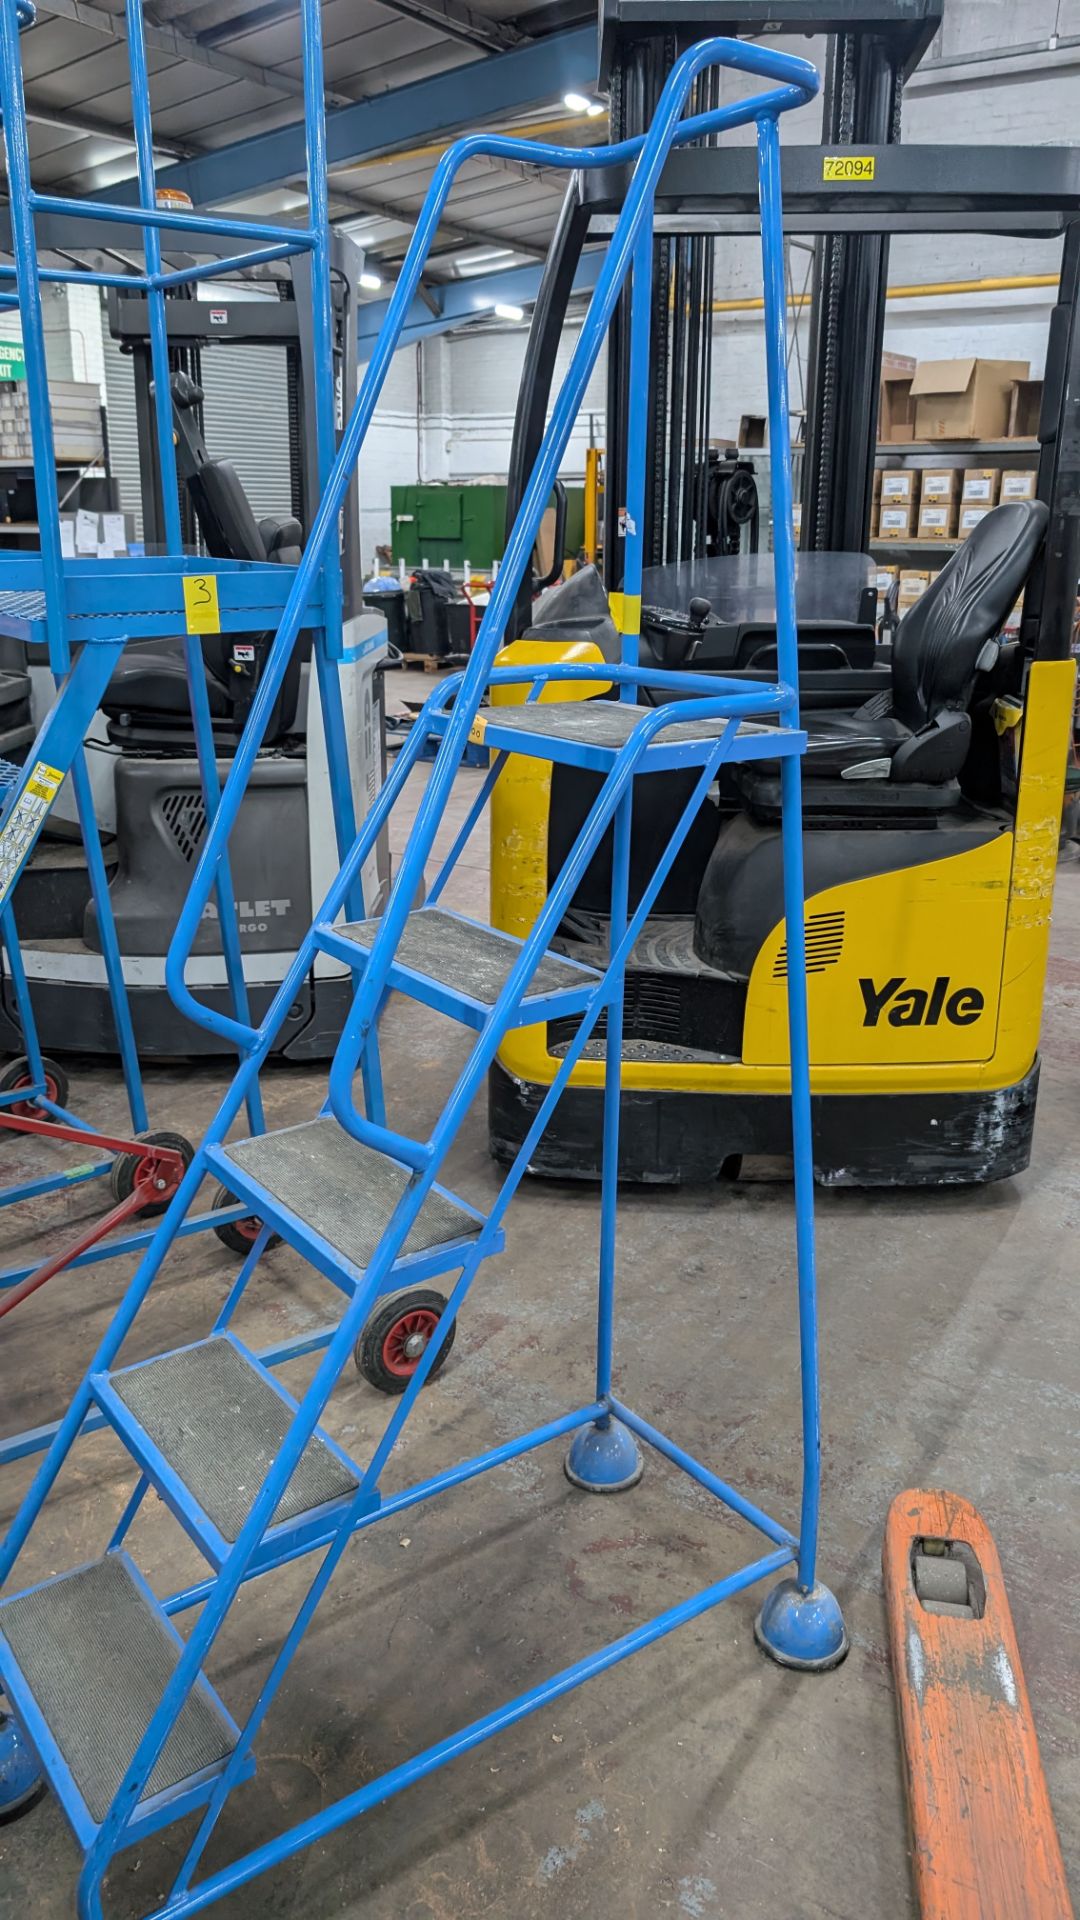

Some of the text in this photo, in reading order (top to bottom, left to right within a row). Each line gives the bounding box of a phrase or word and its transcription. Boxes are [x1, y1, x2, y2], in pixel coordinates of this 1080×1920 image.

[825, 160, 873, 176] 72094
[193, 578, 212, 606] 3
[201, 899, 291, 919] ALET
[858, 976, 985, 1028] Yale
